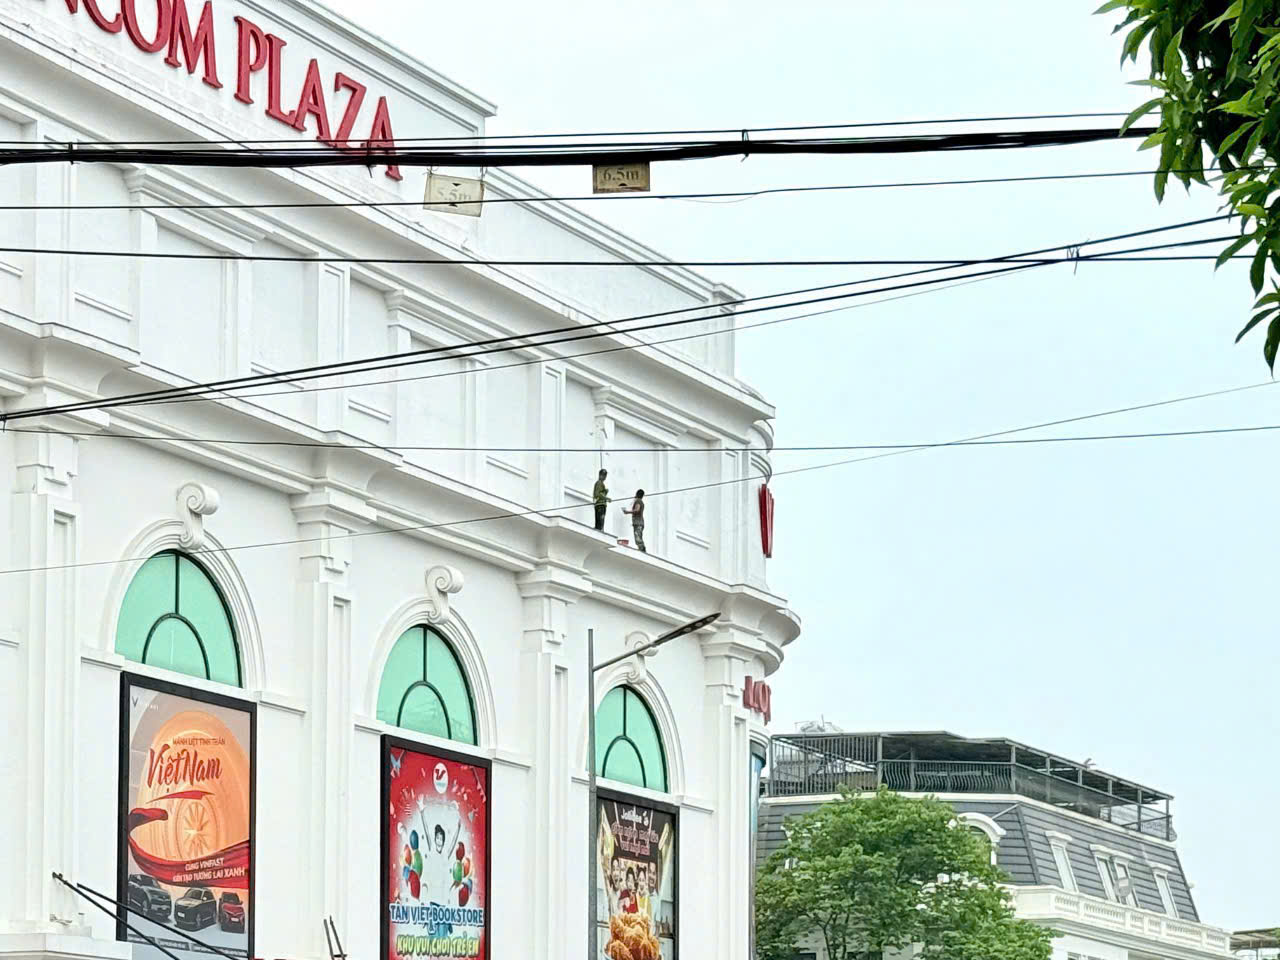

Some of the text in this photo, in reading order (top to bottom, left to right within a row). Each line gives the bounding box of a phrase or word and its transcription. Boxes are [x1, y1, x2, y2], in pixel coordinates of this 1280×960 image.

[234, 16, 403, 181] PLAZA
[602, 167, 639, 182] 6.5m
[224, 866, 245, 878] XANH
[432, 907, 483, 924] BOOKSTORE
[397, 935, 415, 955] KHU
